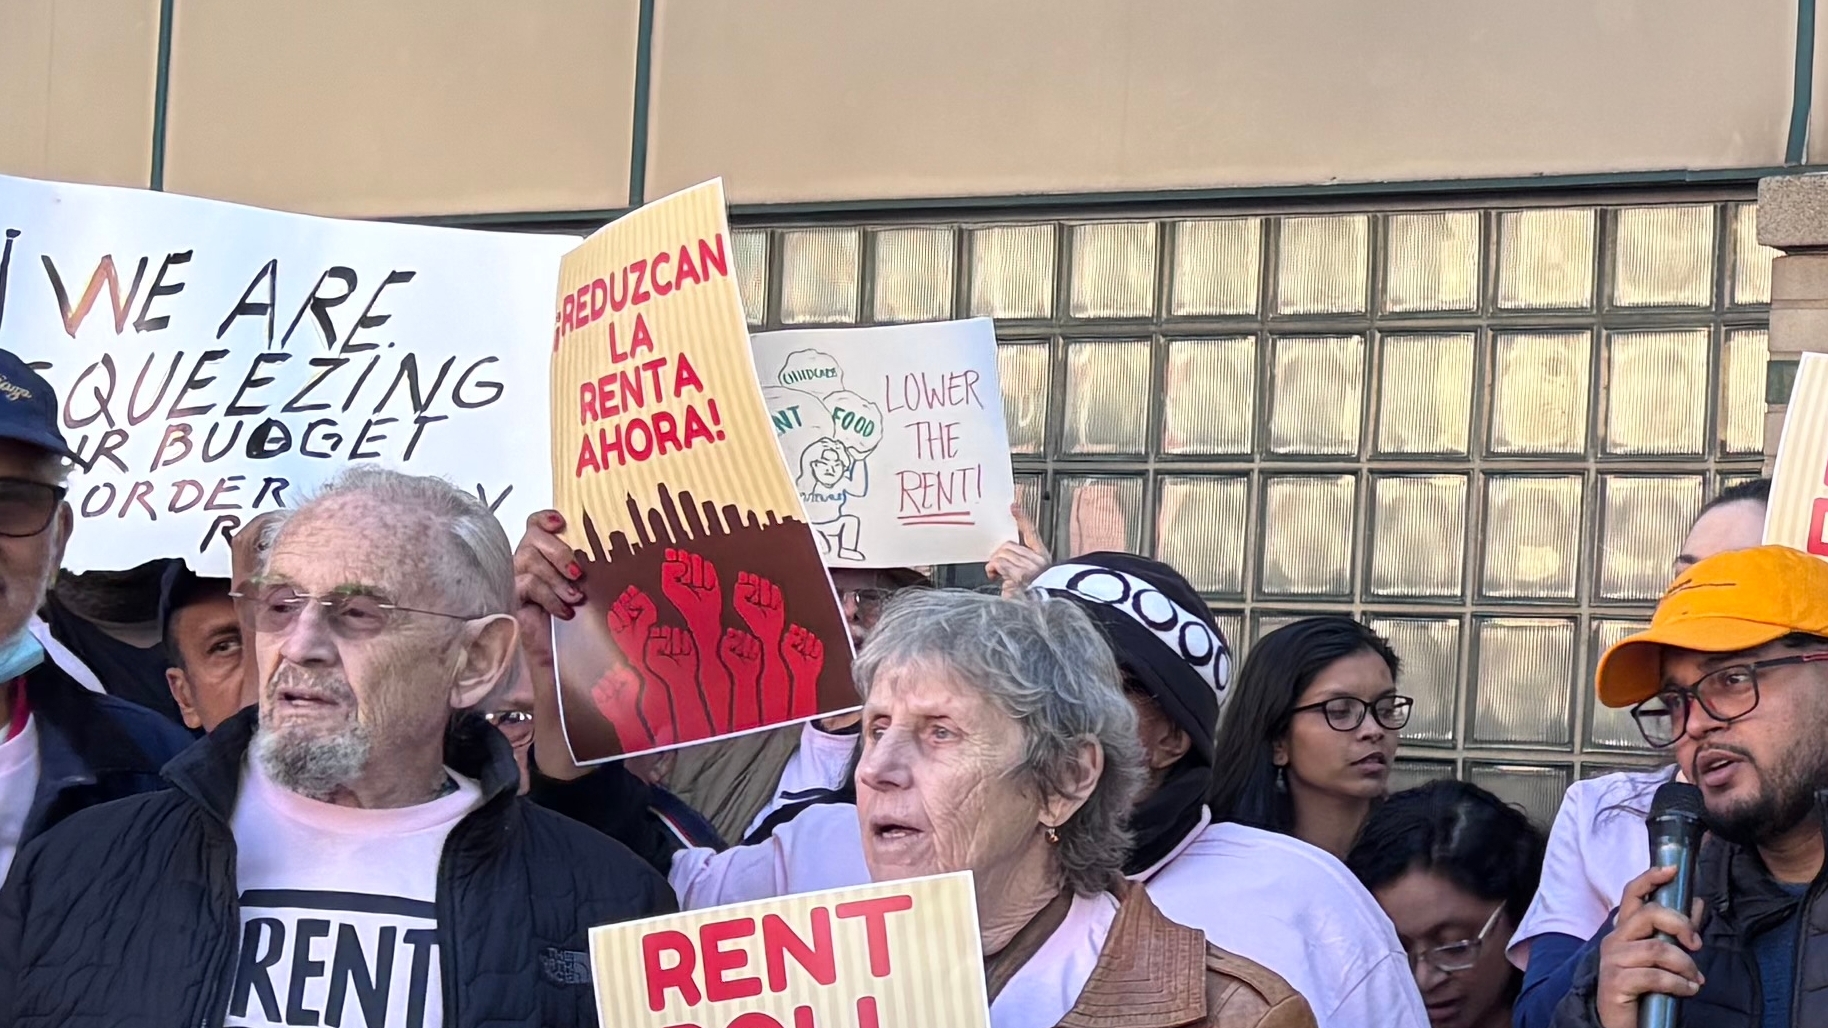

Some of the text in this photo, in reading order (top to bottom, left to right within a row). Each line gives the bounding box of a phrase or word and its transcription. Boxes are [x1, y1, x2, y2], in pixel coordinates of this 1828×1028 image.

[41, 249, 193, 338] WE
[609, 312, 654, 364] LA
[25, 348, 505, 431] QUEEZING
[580, 352, 703, 426] RENTA
[885, 369, 984, 412] LOWER
[574, 398, 726, 478] AHORA!
[832, 405, 875, 437] FOOD
[904, 421, 961, 460] THE
[81, 475, 290, 521] ORDER
[895, 463, 982, 514] RENT!
[642, 894, 912, 1012] RENT
